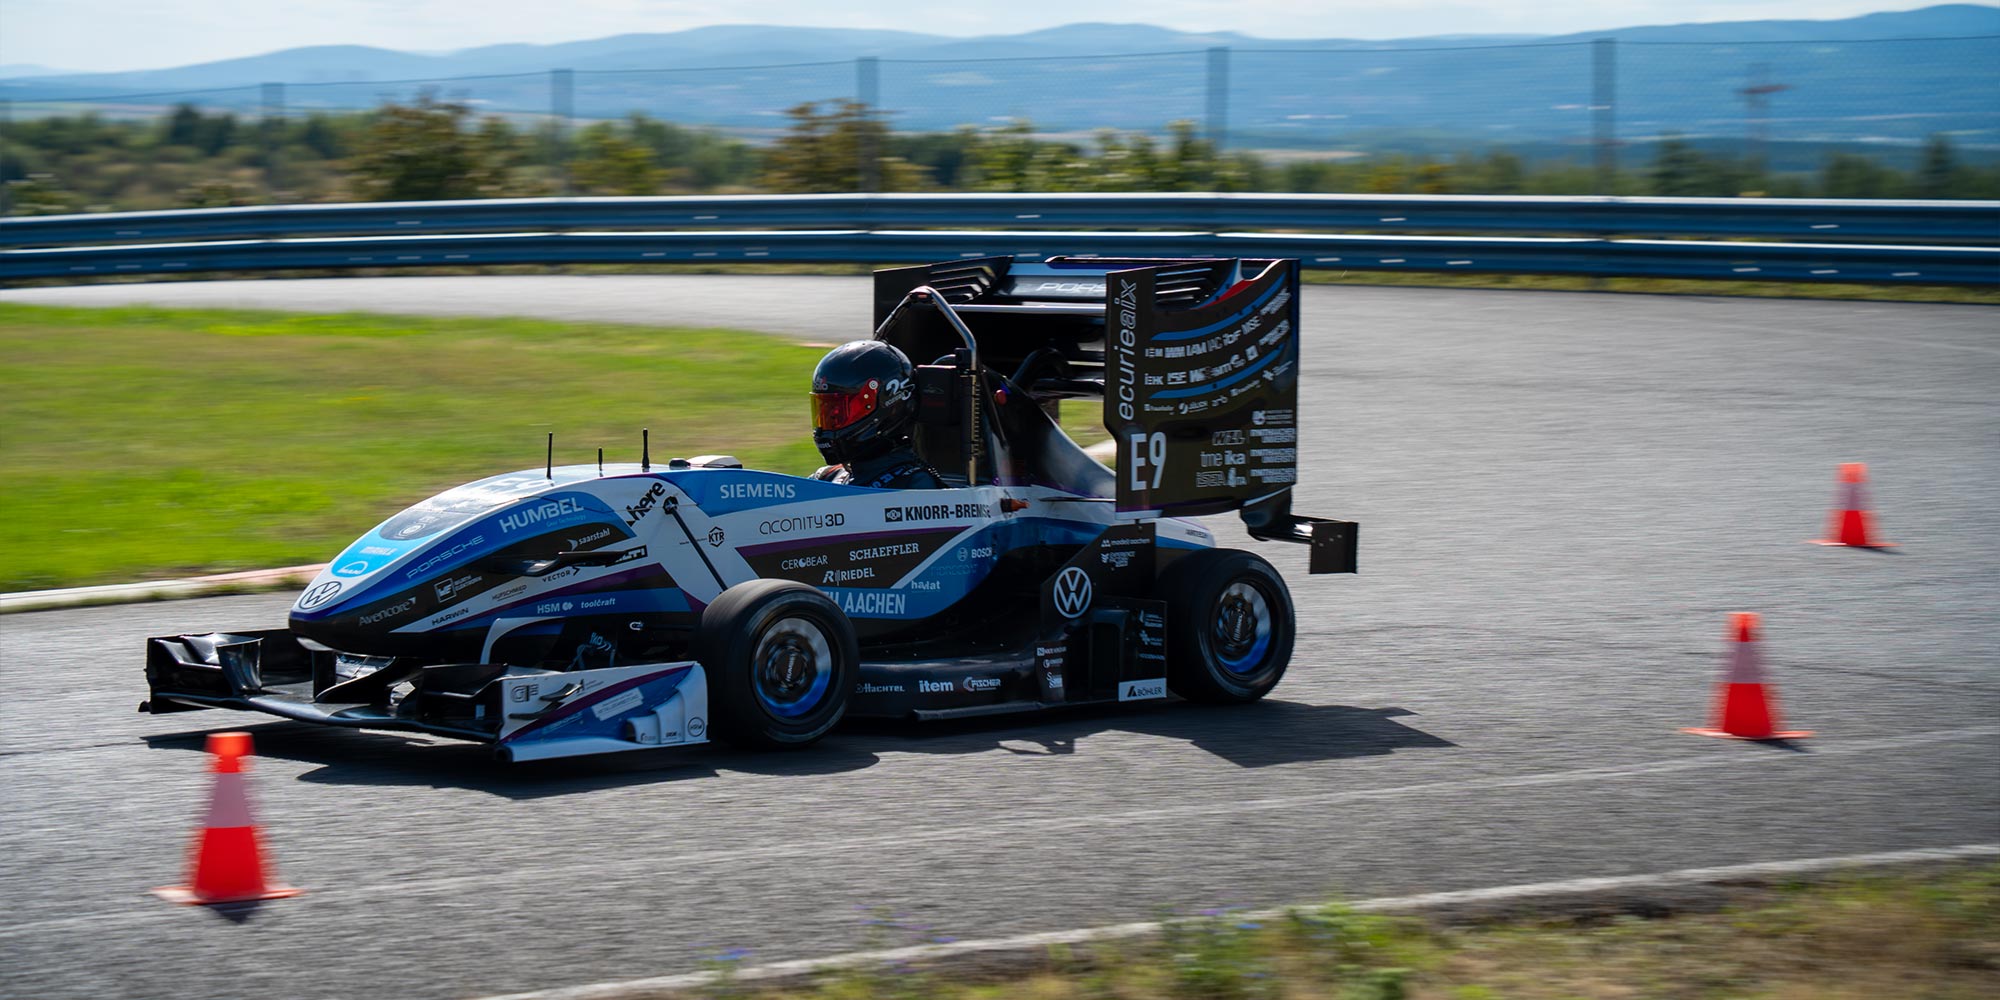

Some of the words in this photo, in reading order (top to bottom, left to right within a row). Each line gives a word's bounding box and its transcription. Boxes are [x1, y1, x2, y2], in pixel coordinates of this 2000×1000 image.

[1034, 282, 1107, 293] PORS
[1115, 279, 1137, 420] ecurieaix
[1130, 431, 1167, 491] E9
[720, 484, 796, 499] SIEMENS
[626, 482, 665, 521] here
[499, 497, 584, 533] HUMBEL
[825, 513, 845, 527] 3D
[579, 528, 611, 545] saarstahl
[708, 532, 725, 543] KTR
[406, 535, 486, 579] PORSCHE
[849, 543, 919, 561] SCHAEFFLER
[542, 570, 570, 583] VECTOR
[840, 567, 875, 581] RIEDEL
[537, 603, 560, 614] HSM
[581, 597, 616, 609] toolcraft
[844, 592, 906, 615] AACHEN
[432, 607, 469, 626] HARWIN
[919, 680, 954, 693] item
